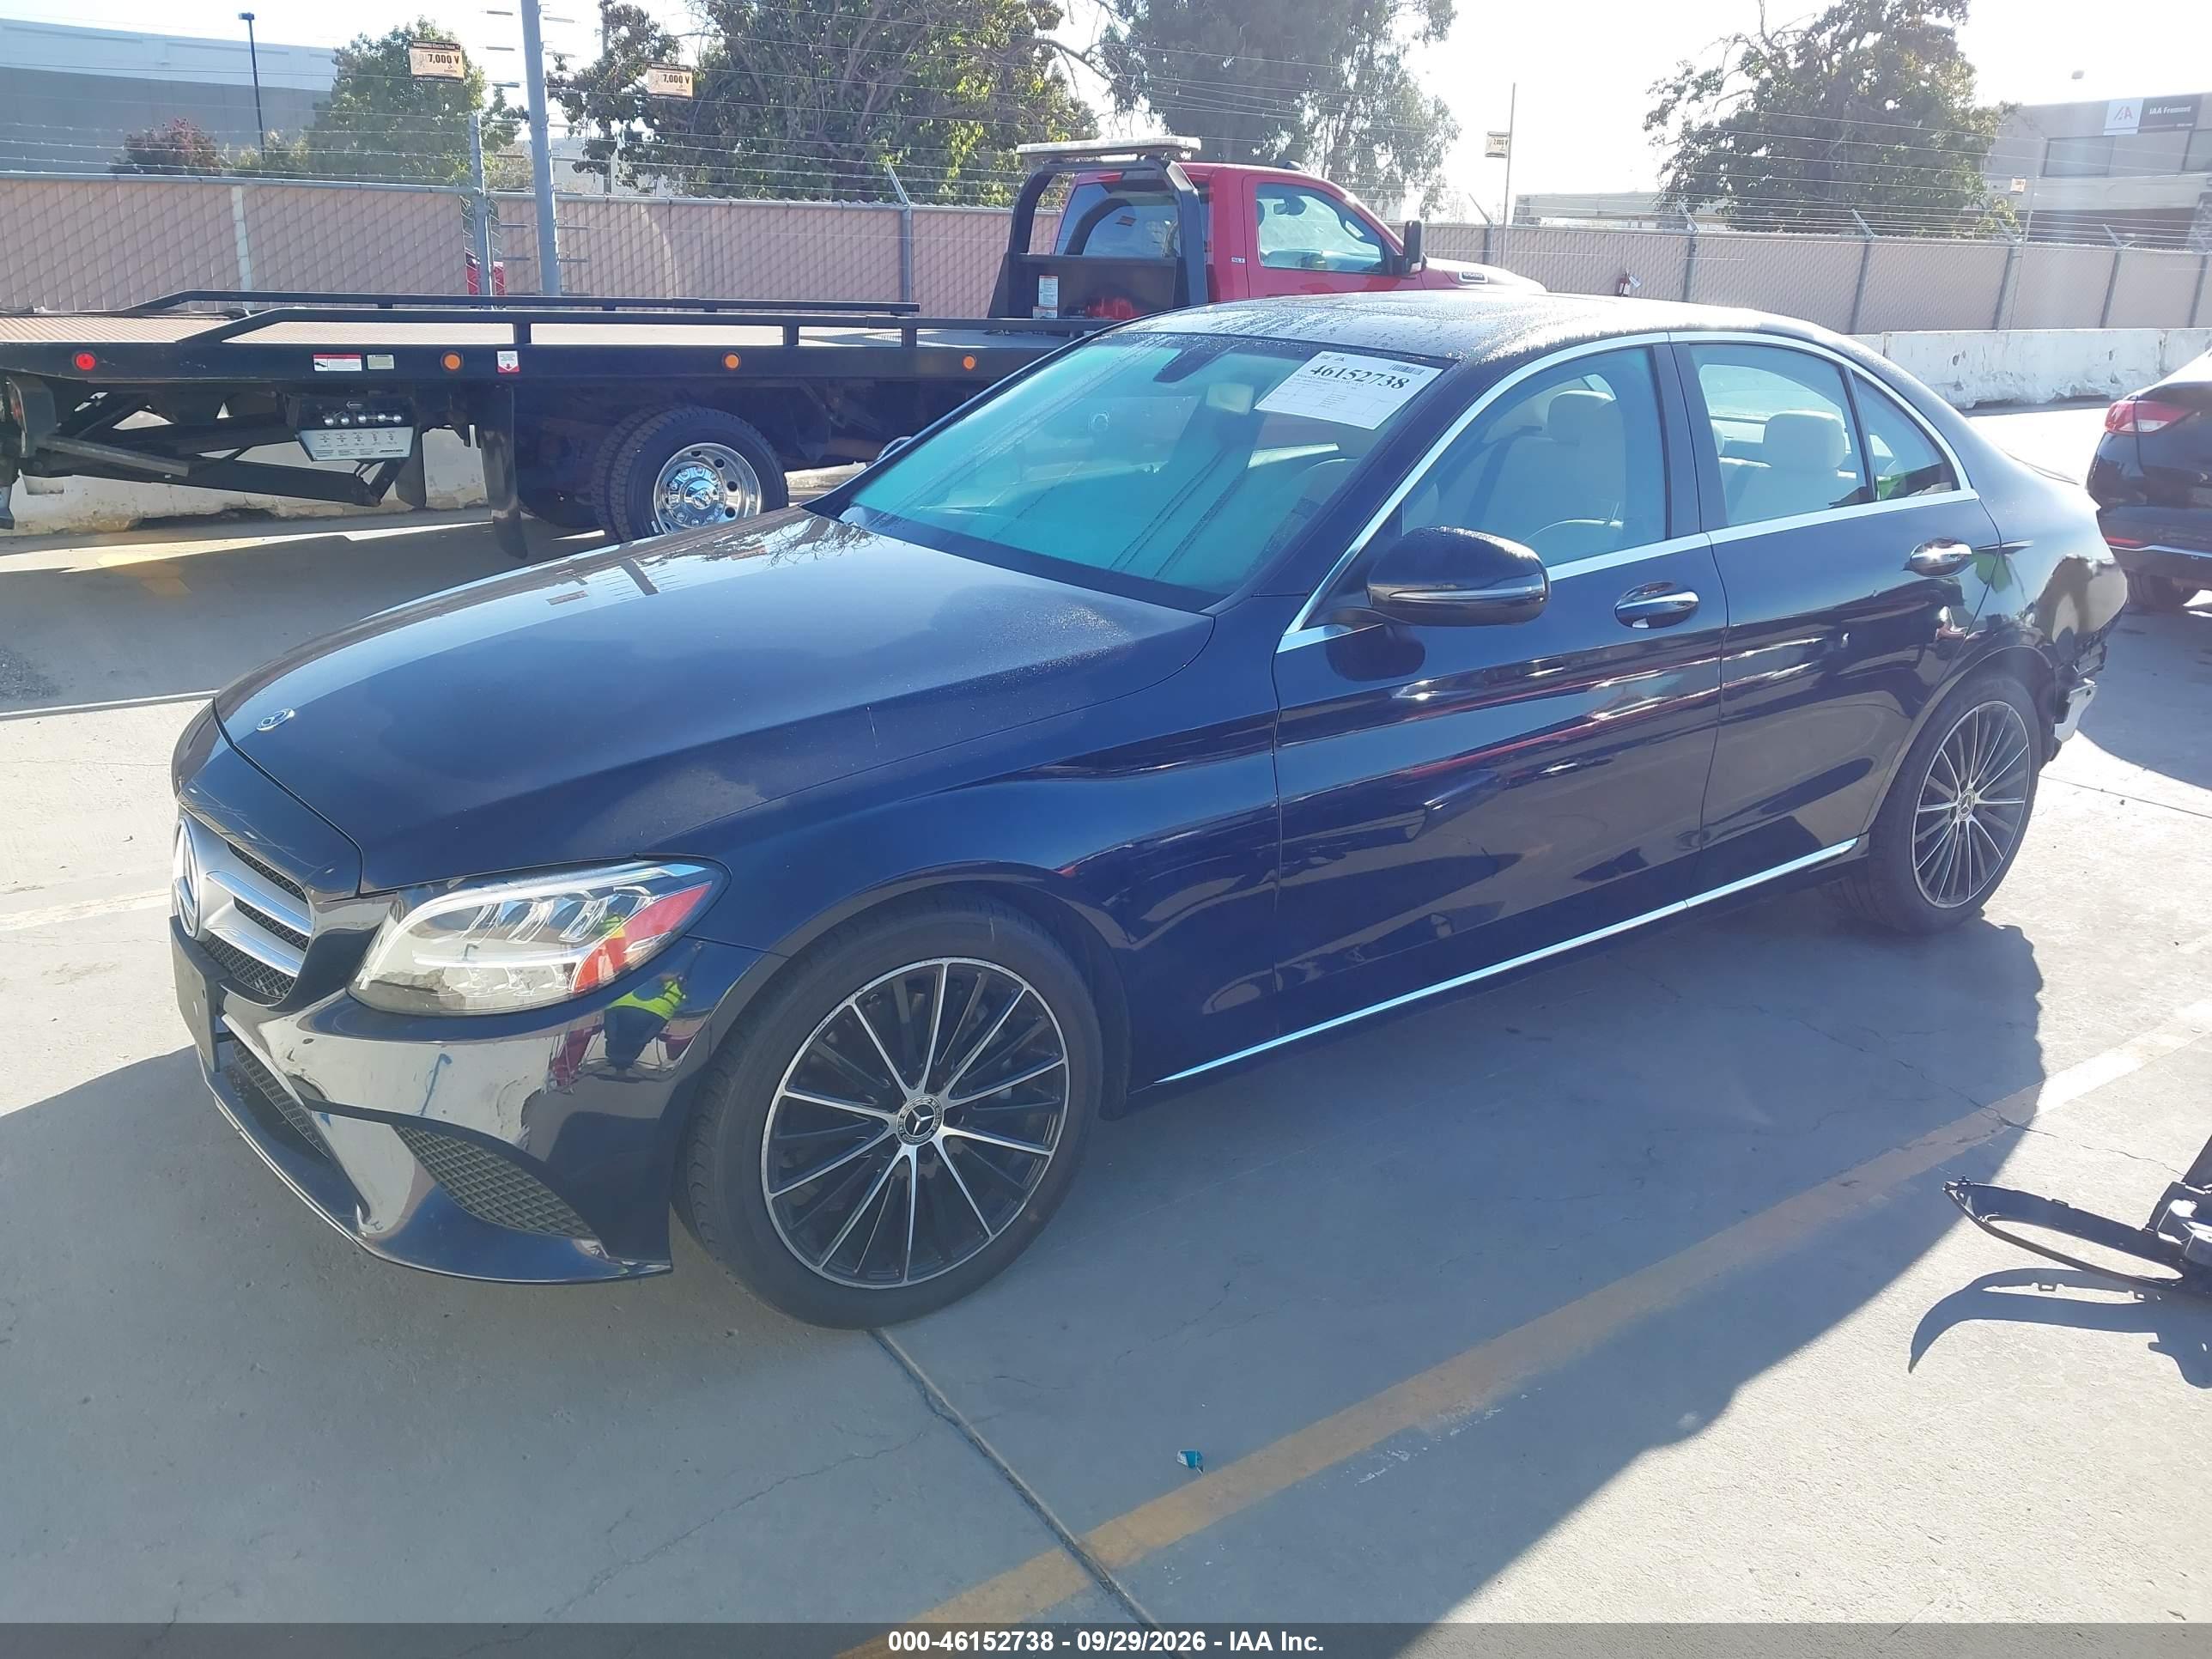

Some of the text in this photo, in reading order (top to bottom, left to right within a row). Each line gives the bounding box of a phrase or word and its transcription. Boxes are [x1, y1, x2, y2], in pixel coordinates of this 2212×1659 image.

[428, 54, 459, 64] 7,000 V
[684, 76, 690, 84] V
[1310, 364, 1410, 390] 46152738
